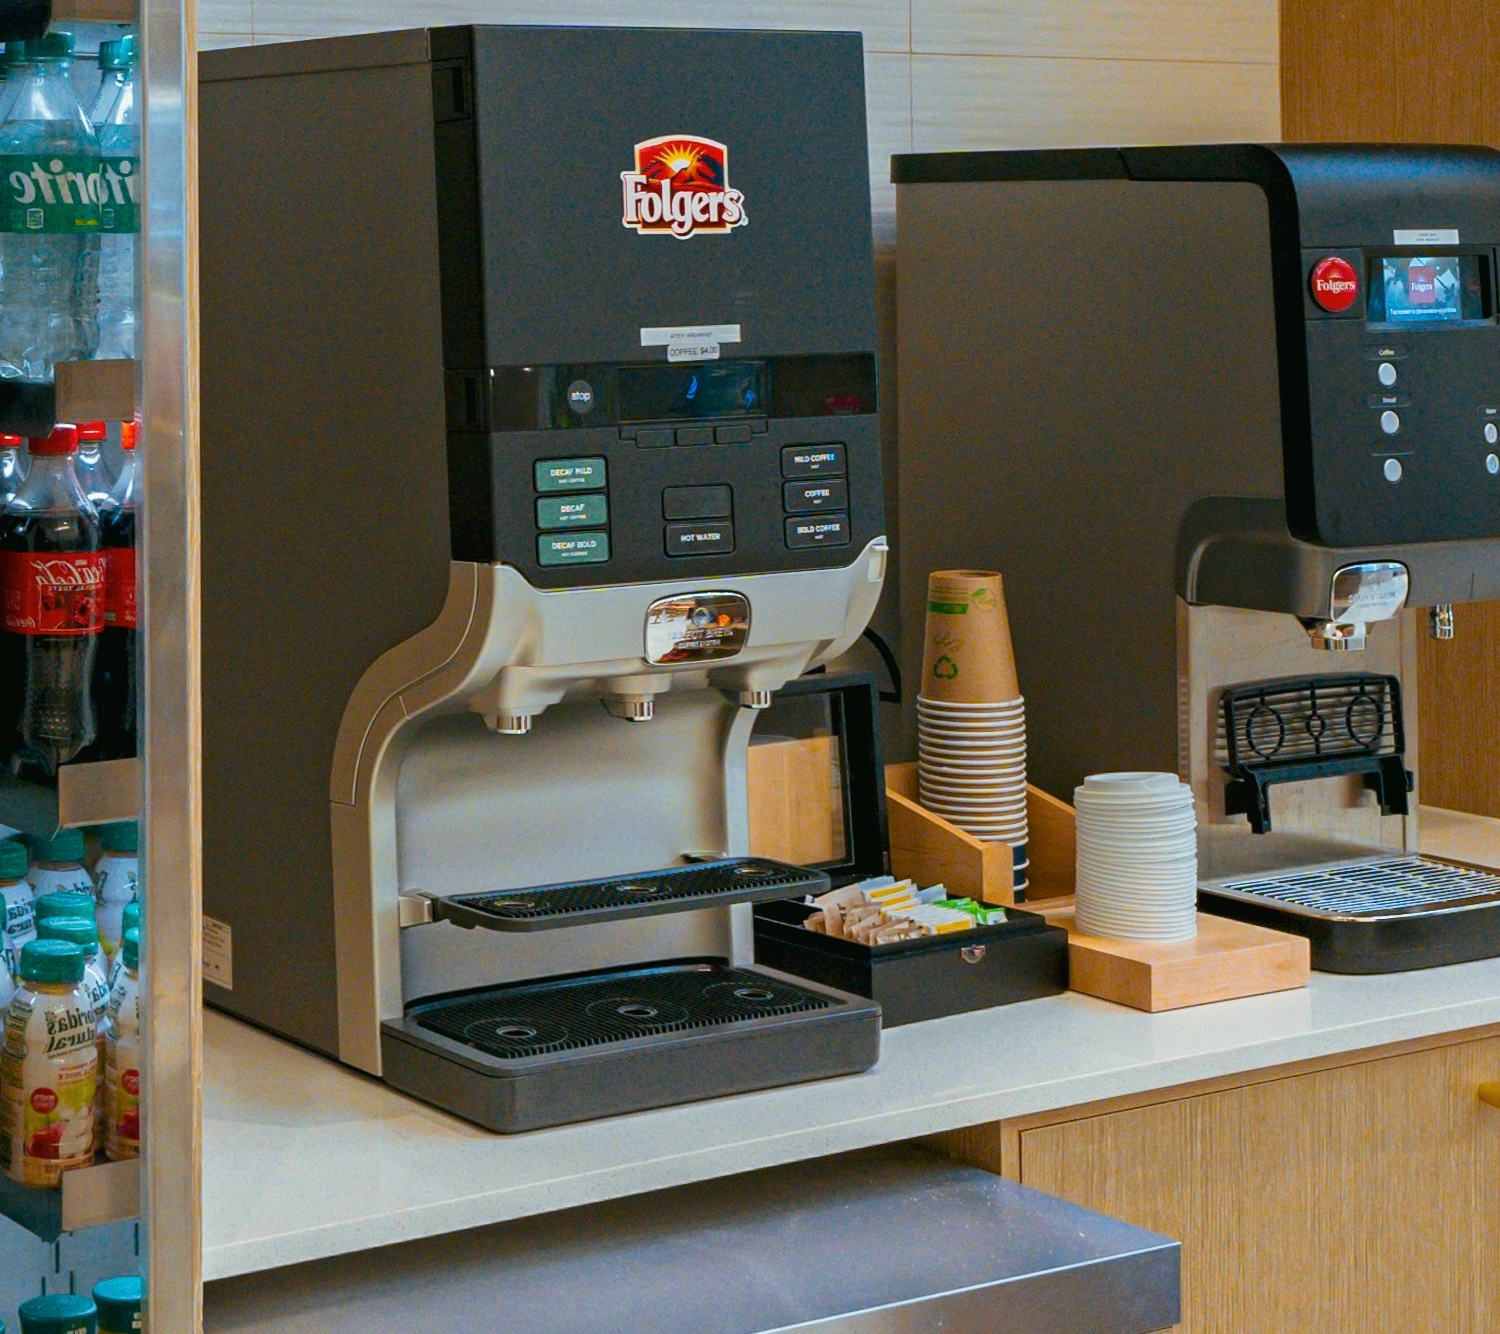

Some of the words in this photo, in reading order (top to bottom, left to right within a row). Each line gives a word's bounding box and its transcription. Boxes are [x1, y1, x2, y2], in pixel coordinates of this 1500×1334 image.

[624, 174, 742, 234] Folgers
[1316, 279, 1355, 294] Folgers
[670, 348, 698, 356] COFFEE
[571, 390, 591, 403] stop
[561, 504, 585, 513] DECAF
[552, 542, 575, 550] DECAF
